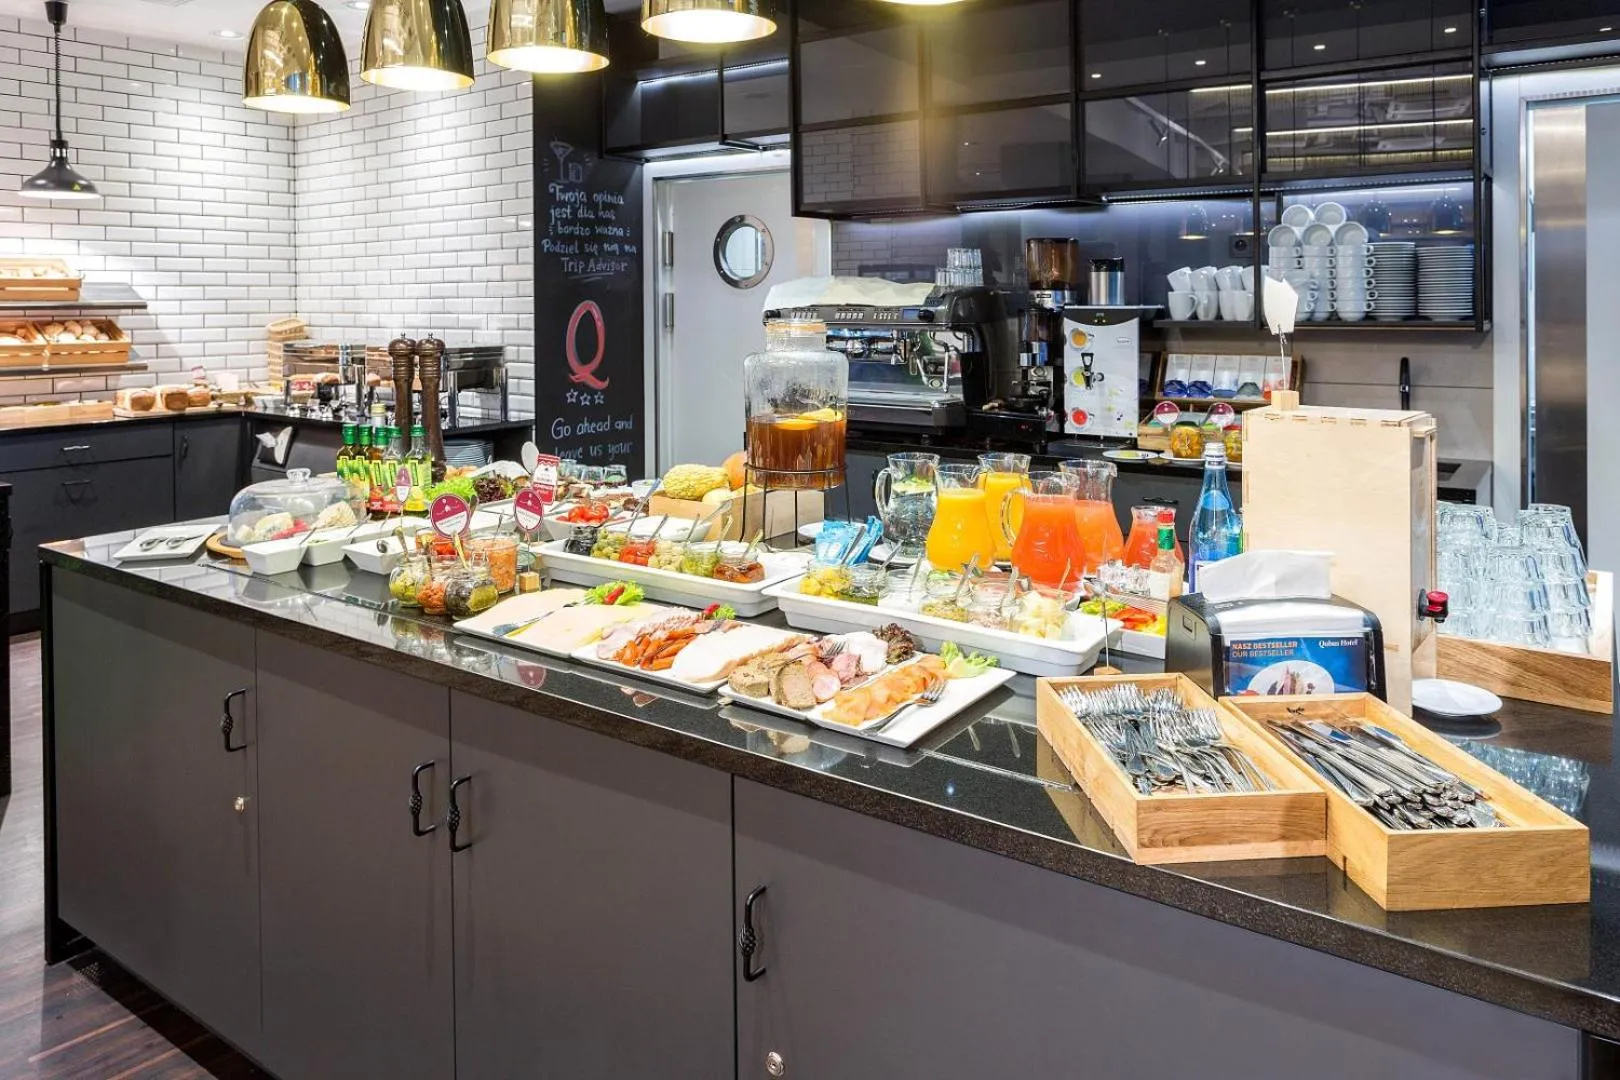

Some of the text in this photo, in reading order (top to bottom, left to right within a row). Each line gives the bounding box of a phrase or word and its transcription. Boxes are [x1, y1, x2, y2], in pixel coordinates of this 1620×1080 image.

[549, 183, 624, 209] Twoja opinia
[550, 205, 572, 225] jest
[577, 204, 595, 218] dla
[560, 257, 628, 274] Trip Advisor
[566, 300, 610, 390] Q
[551, 414, 634, 440] Go ahead and
[590, 444, 603, 457] us
[608, 441, 634, 461] your
[1253, 640, 1298, 650] BESTSELLER
[1340, 638, 1359, 647] Hotel
[1249, 648, 1294, 658] BESTSELLER
